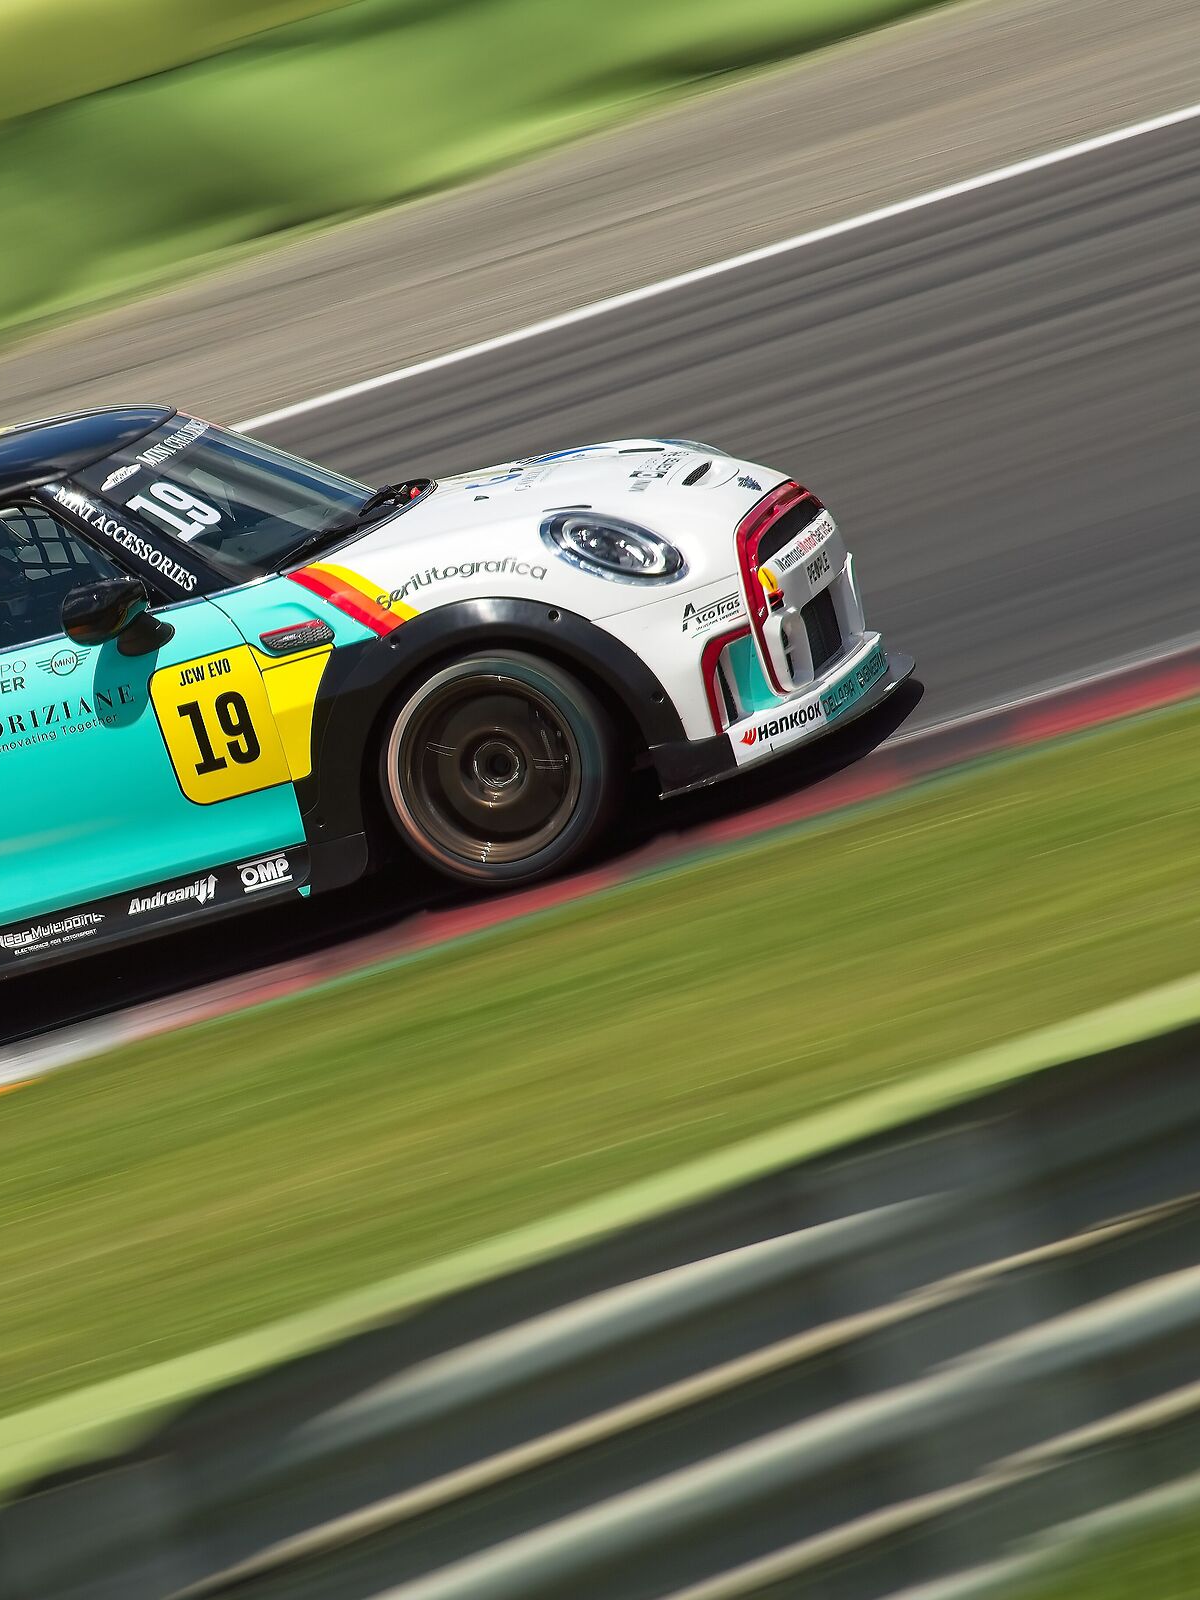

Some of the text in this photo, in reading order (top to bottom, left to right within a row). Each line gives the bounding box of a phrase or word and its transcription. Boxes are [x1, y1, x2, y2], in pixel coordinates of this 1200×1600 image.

[136, 443, 177, 467] MINI
[125, 482, 221, 543] 19
[53, 486, 197, 592] MINI ACCESSORIES
[54, 658, 76, 668] MINI
[179, 658, 231, 687] JCW EVO
[62, 712, 118, 737] Together
[177, 691, 261, 776] 19
[240, 858, 290, 887] OMP
[127, 881, 199, 915] Andreani
